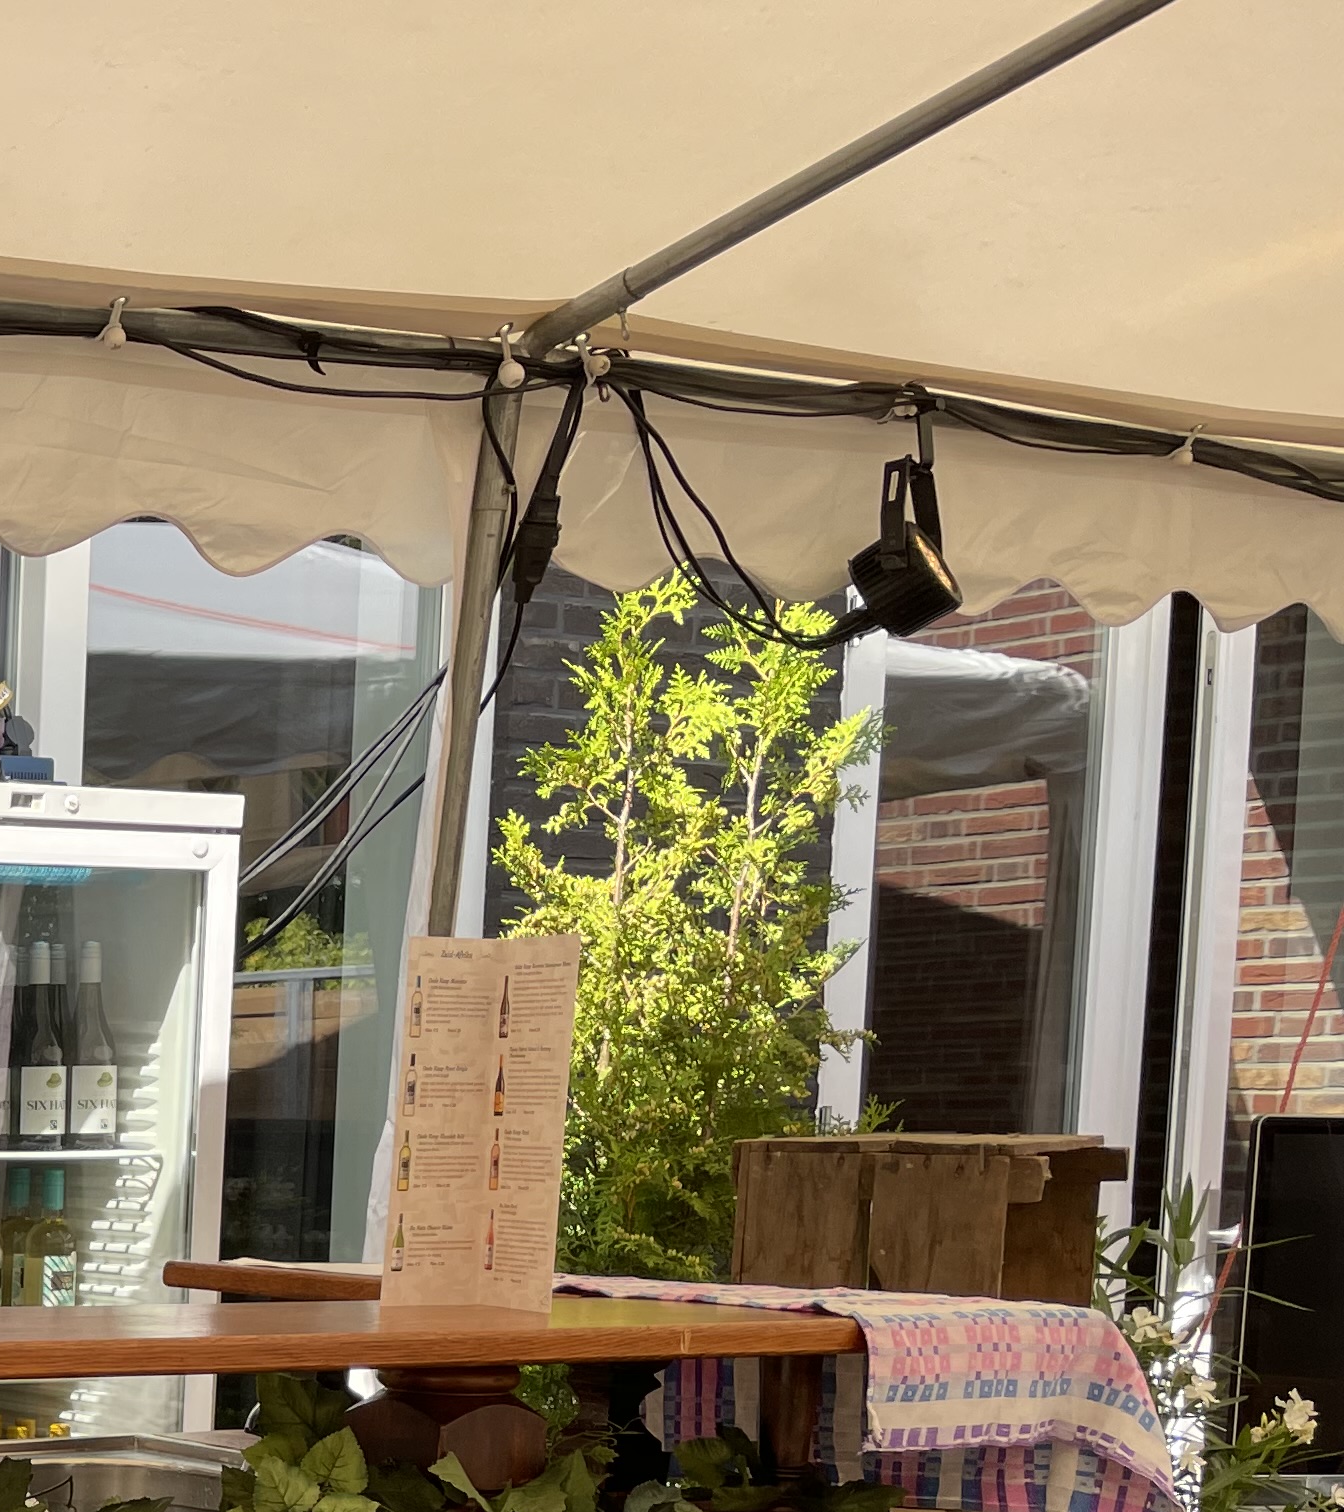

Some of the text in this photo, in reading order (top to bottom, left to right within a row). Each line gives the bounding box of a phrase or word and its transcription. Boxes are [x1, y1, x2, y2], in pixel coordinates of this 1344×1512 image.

[26, 1100, 65, 1111] SIX HA
[77, 1099, 116, 1110] SIX HA
